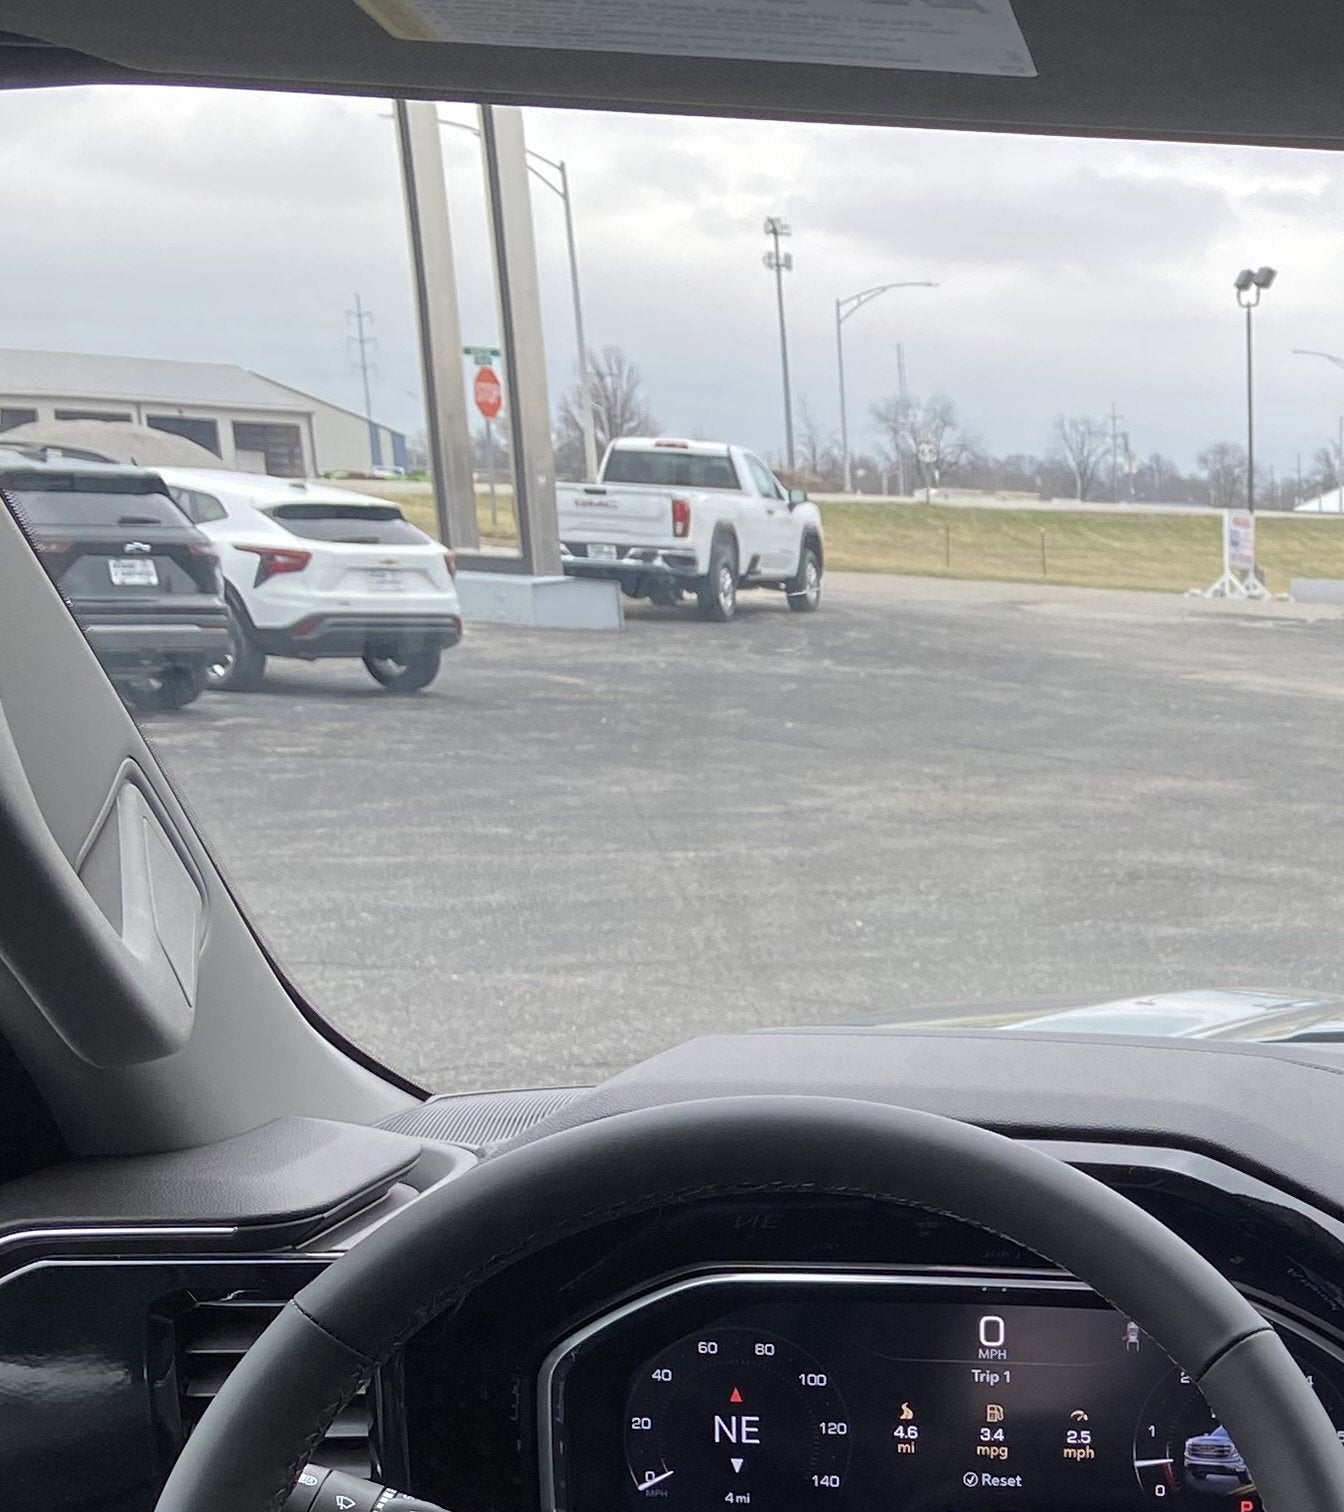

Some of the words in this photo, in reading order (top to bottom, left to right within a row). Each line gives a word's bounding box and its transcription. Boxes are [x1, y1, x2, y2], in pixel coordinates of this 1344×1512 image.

[979, 1316, 1005, 1347] 0
[698, 1341, 718, 1354] 60
[754, 1343, 775, 1356] 80
[978, 1349, 1007, 1360] MPH
[651, 1369, 672, 1381] 40
[798, 1373, 828, 1386] 100
[971, 1369, 1000, 1386] Trip
[1003, 1370, 1011, 1383] 1
[631, 1417, 651, 1430] 20
[714, 1415, 761, 1444] NE
[819, 1422, 847, 1435] 120
[892, 1426, 918, 1440] 4.6
[979, 1428, 1005, 1441] 3.4
[1066, 1430, 1092, 1444] 2.5
[1148, 1425, 1156, 1437] 1
[897, 1441, 915, 1454] mi
[976, 1445, 1008, 1460] mpg
[1063, 1446, 1095, 1461] mph
[811, 1475, 840, 1488] 140
[981, 1474, 1022, 1487] Reset
[1155, 1485, 1166, 1497] 0
[724, 1492, 735, 1504] 4
[736, 1492, 750, 1503] mi
